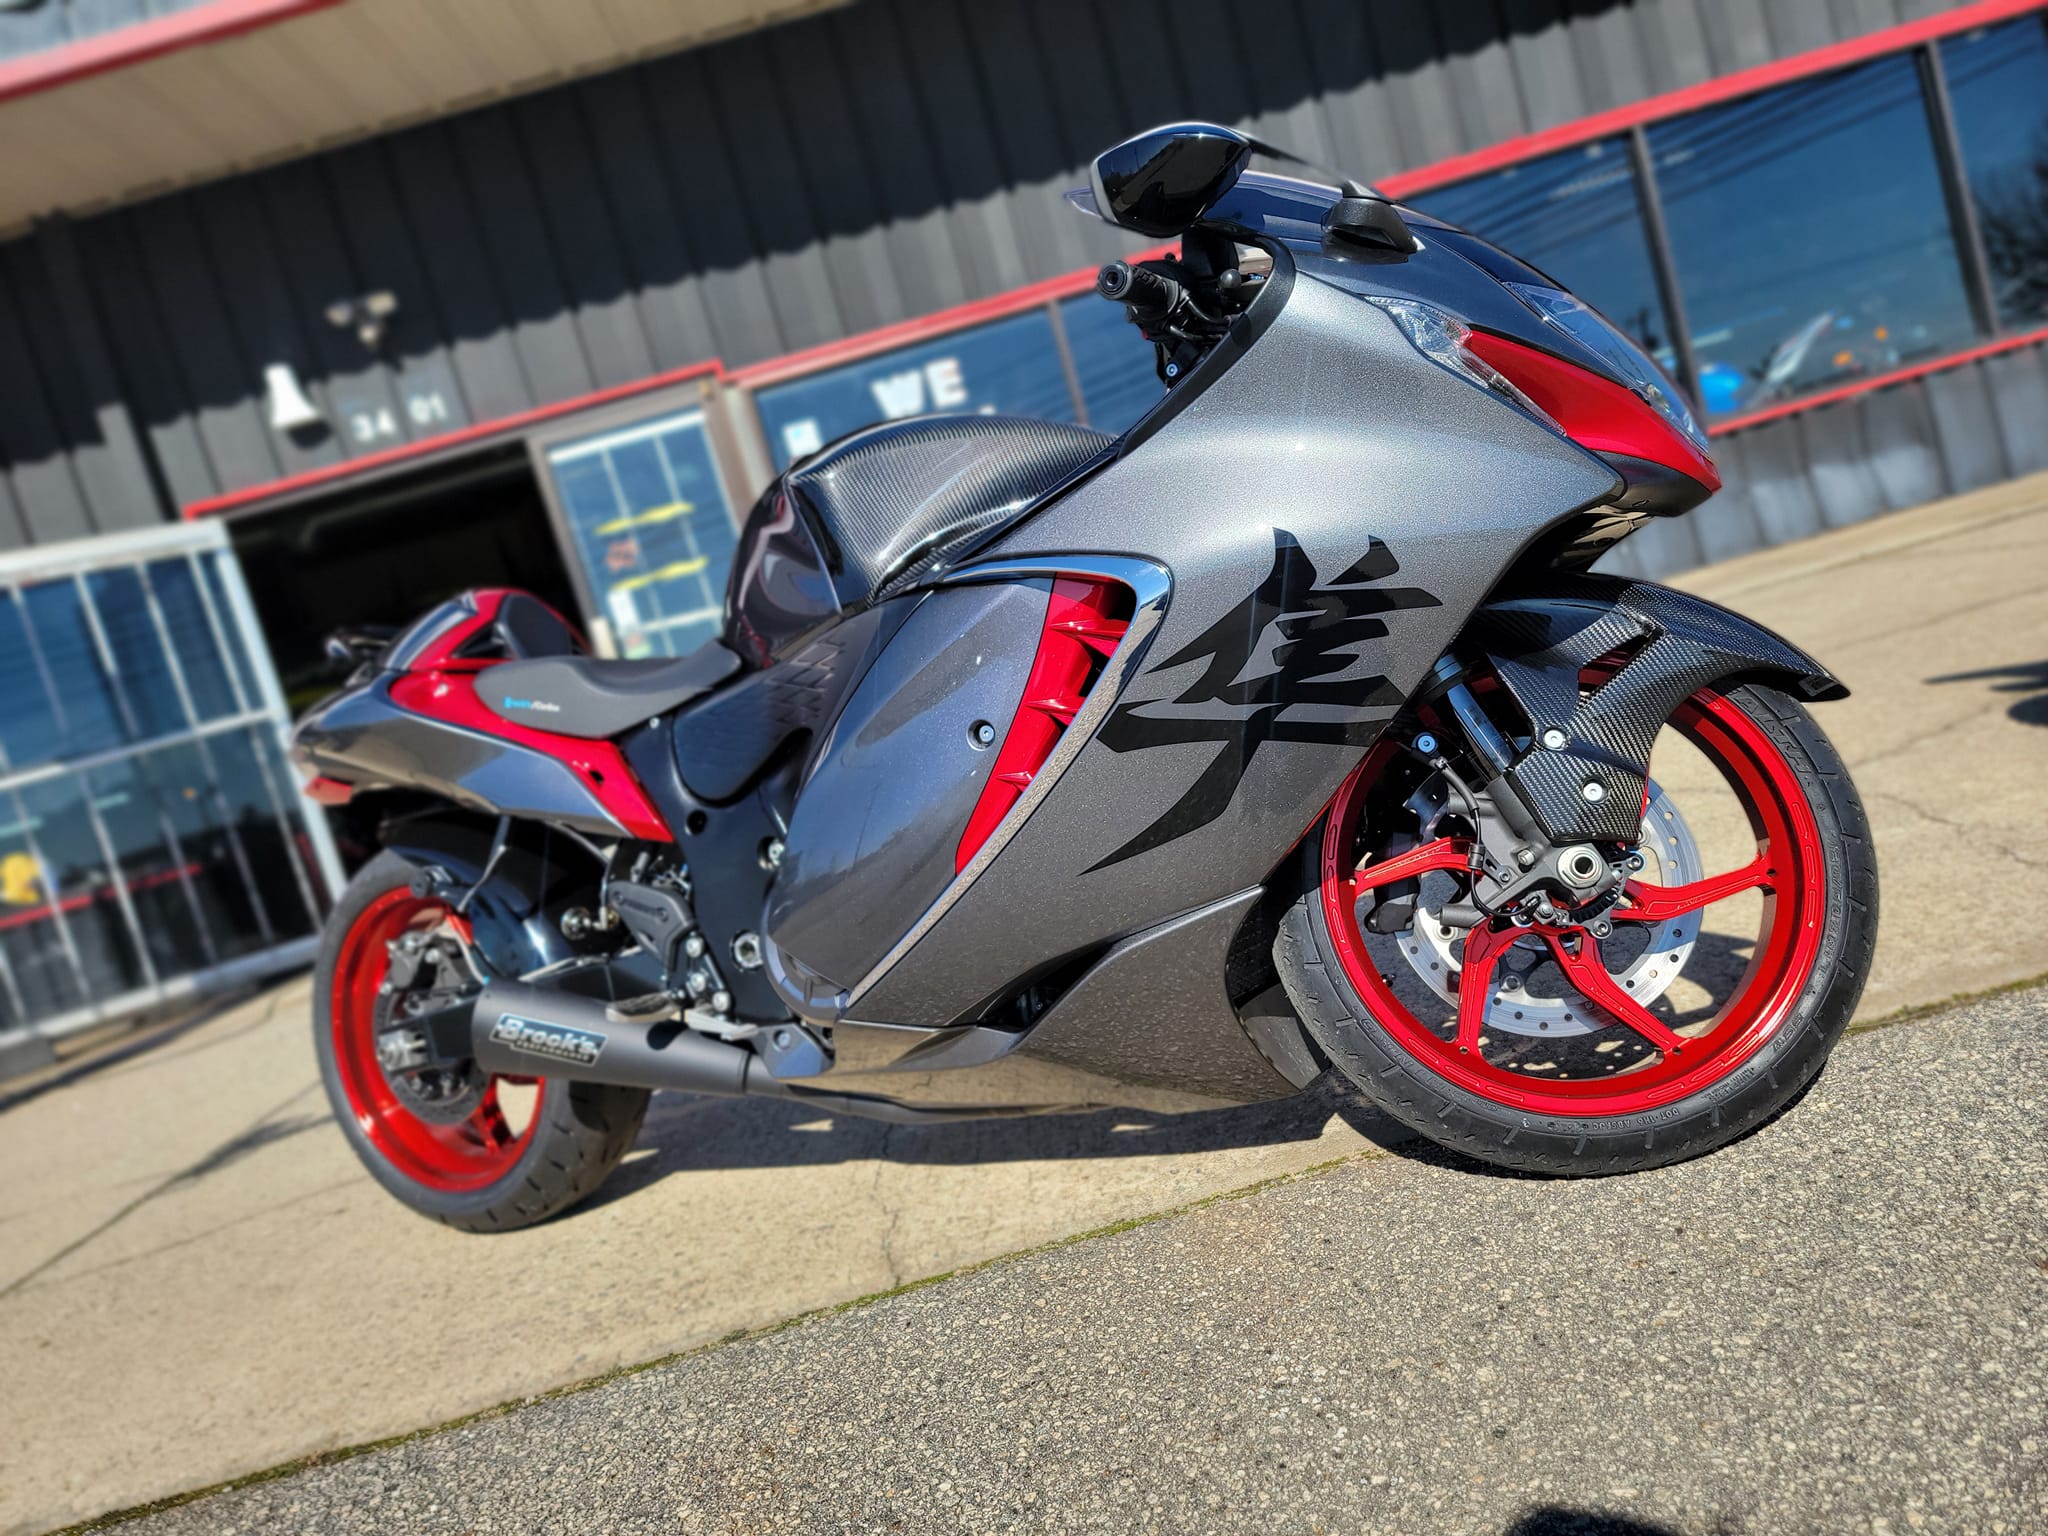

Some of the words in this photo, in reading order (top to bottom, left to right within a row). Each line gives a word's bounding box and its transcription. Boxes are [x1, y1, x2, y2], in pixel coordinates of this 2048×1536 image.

[870, 357, 969, 419] WE
[1077, 527, 1444, 877] 隼
[499, 1018, 596, 1055] Brock's
